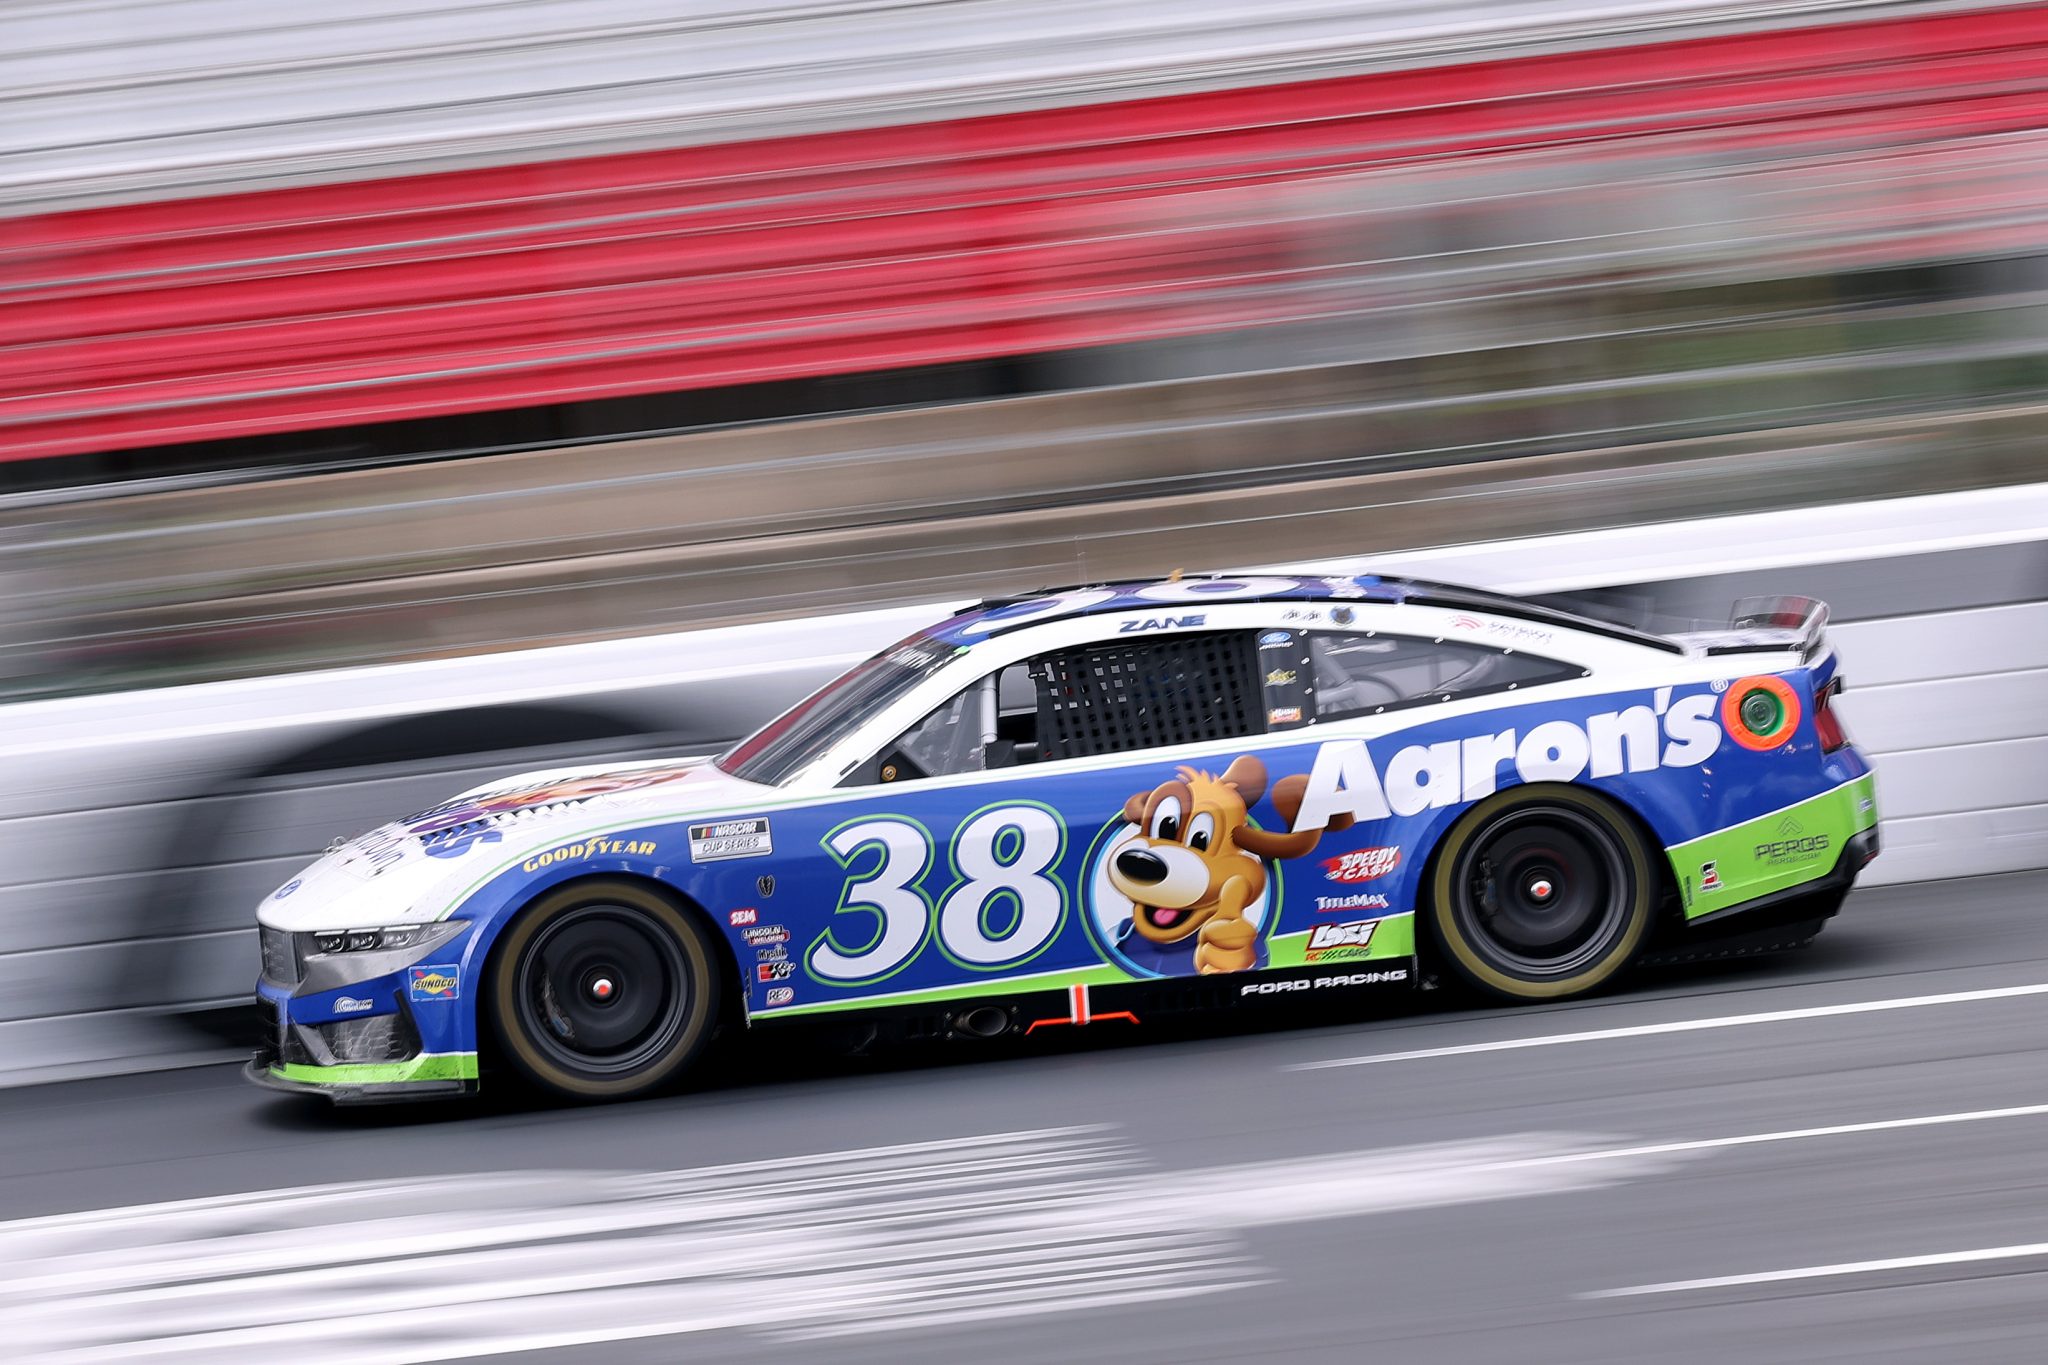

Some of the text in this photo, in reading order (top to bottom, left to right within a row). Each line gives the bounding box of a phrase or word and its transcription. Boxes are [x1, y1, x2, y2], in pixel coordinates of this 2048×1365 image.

[1119, 614, 1206, 633] ZANE
[1292, 687, 1722, 833] Aaron's
[715, 822, 757, 838] NASCAR
[702, 837, 760, 853] CUP SERIES
[523, 836, 657, 874] GOODYEAR
[1339, 846, 1400, 871] SPEEDY
[807, 802, 1066, 984] 38
[731, 910, 757, 925] SEM
[744, 926, 781, 938] LINCOLN
[414, 978, 456, 989] SUNOCO
[1241, 969, 1408, 996] FORD RACING
